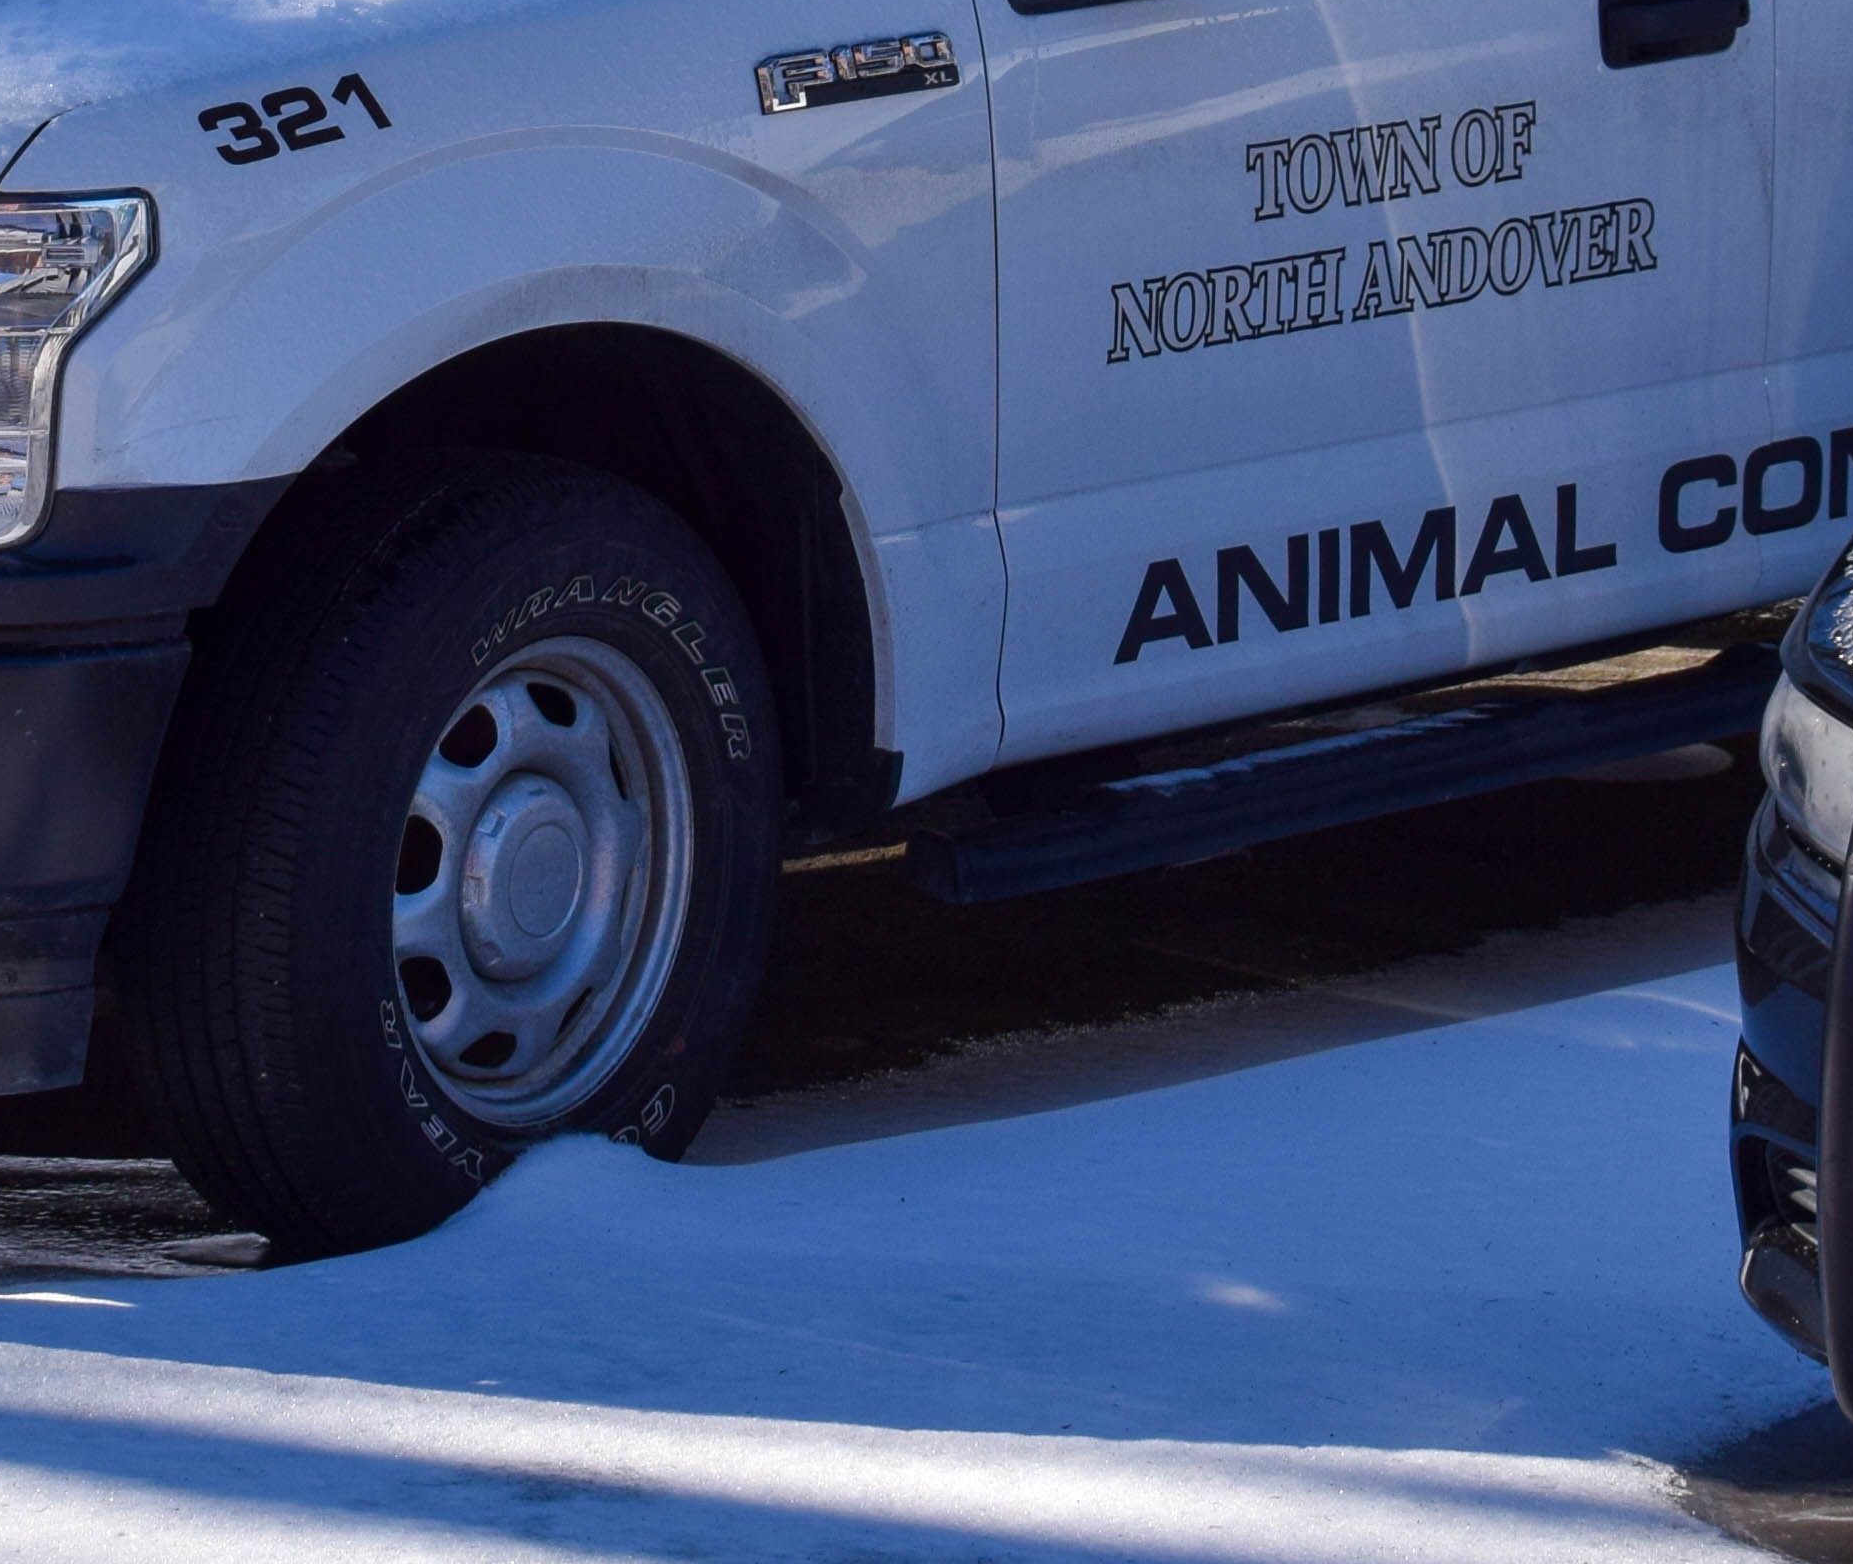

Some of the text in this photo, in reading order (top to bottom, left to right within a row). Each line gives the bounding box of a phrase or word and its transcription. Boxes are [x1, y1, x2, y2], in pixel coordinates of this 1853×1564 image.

[198, 73, 392, 165] 321
[923, 72, 953, 86] XL
[1246, 100, 1536, 221] TOWN OF
[1106, 197, 1658, 364] NORTH ANDOVER
[1113, 482, 1617, 664] ANIMAL
